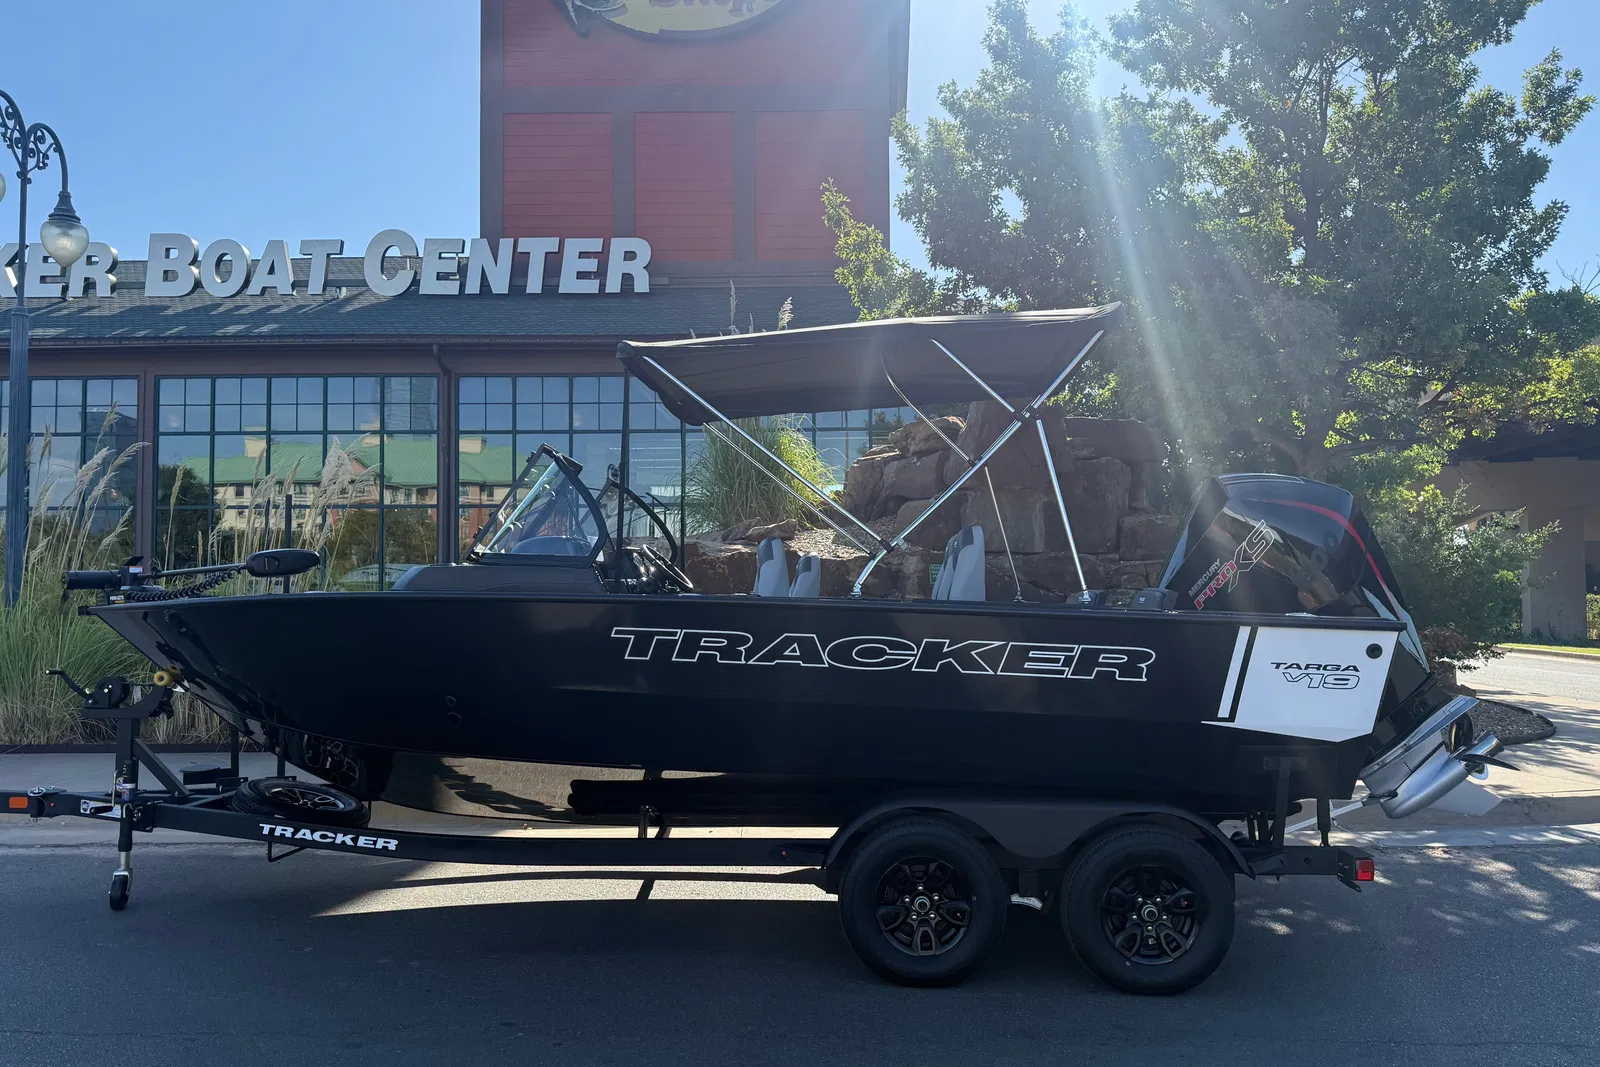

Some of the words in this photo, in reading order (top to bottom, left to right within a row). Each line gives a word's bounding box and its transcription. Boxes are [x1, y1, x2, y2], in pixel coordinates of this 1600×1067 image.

[144, 233, 343, 298] BOAT
[364, 229, 652, 296] CENTER
[1188, 558, 1221, 597] MERCURY
[1194, 560, 1237, 610] PRO
[1228, 519, 1274, 593] XS
[611, 626, 1156, 682] TRACKER
[1271, 662, 1360, 672] TARGA
[1282, 672, 1360, 690] V19
[259, 823, 399, 851] TRACKER
